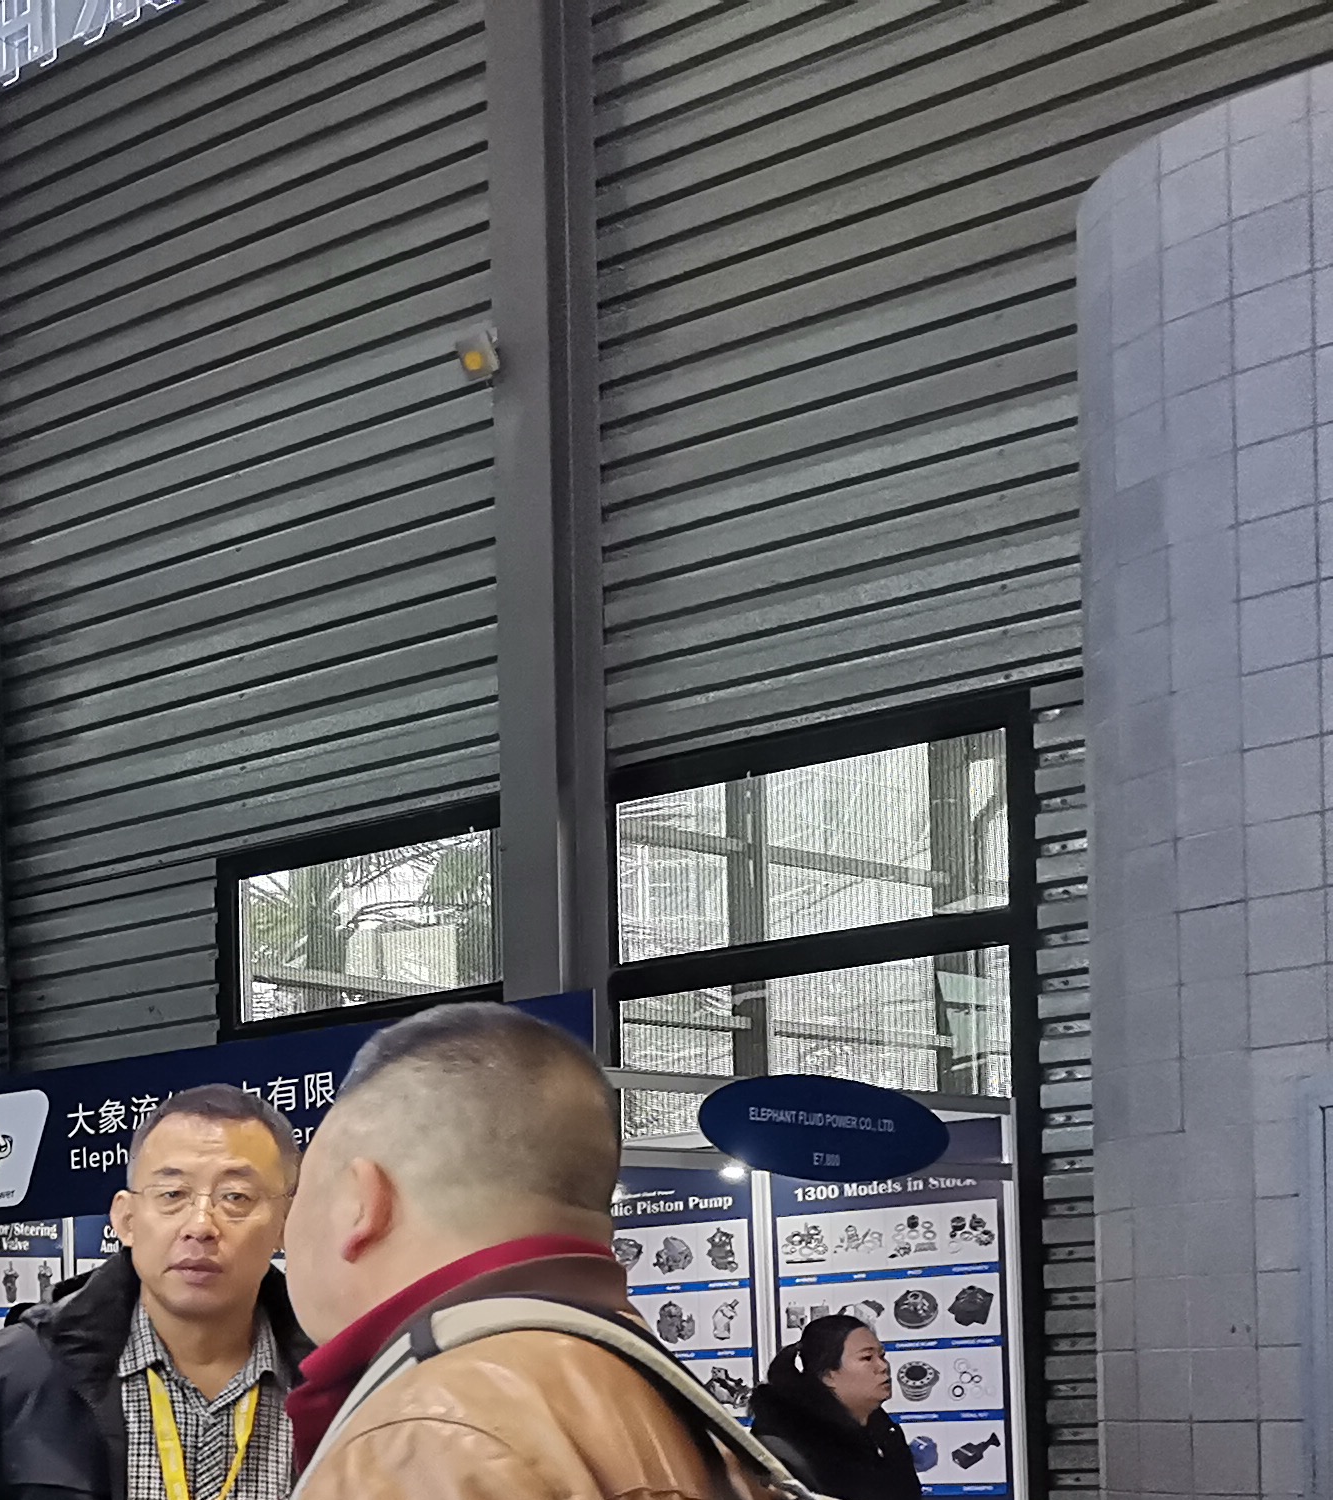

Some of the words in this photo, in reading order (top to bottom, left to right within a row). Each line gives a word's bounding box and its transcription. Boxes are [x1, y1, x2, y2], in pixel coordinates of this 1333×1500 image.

[749, 1106, 797, 1124] ELEPHANT
[798, 1111, 824, 1126] FLUID
[825, 1114, 858, 1129] POWER
[70, 1144, 129, 1172] Eleph
[794, 1184, 840, 1202] 1300
[843, 1179, 902, 1197] Models
[906, 1176, 924, 1191] in
[636, 1200, 684, 1215] Piston
[688, 1196, 733, 1210] Pump
[2, 1236, 30, 1251] Valve
